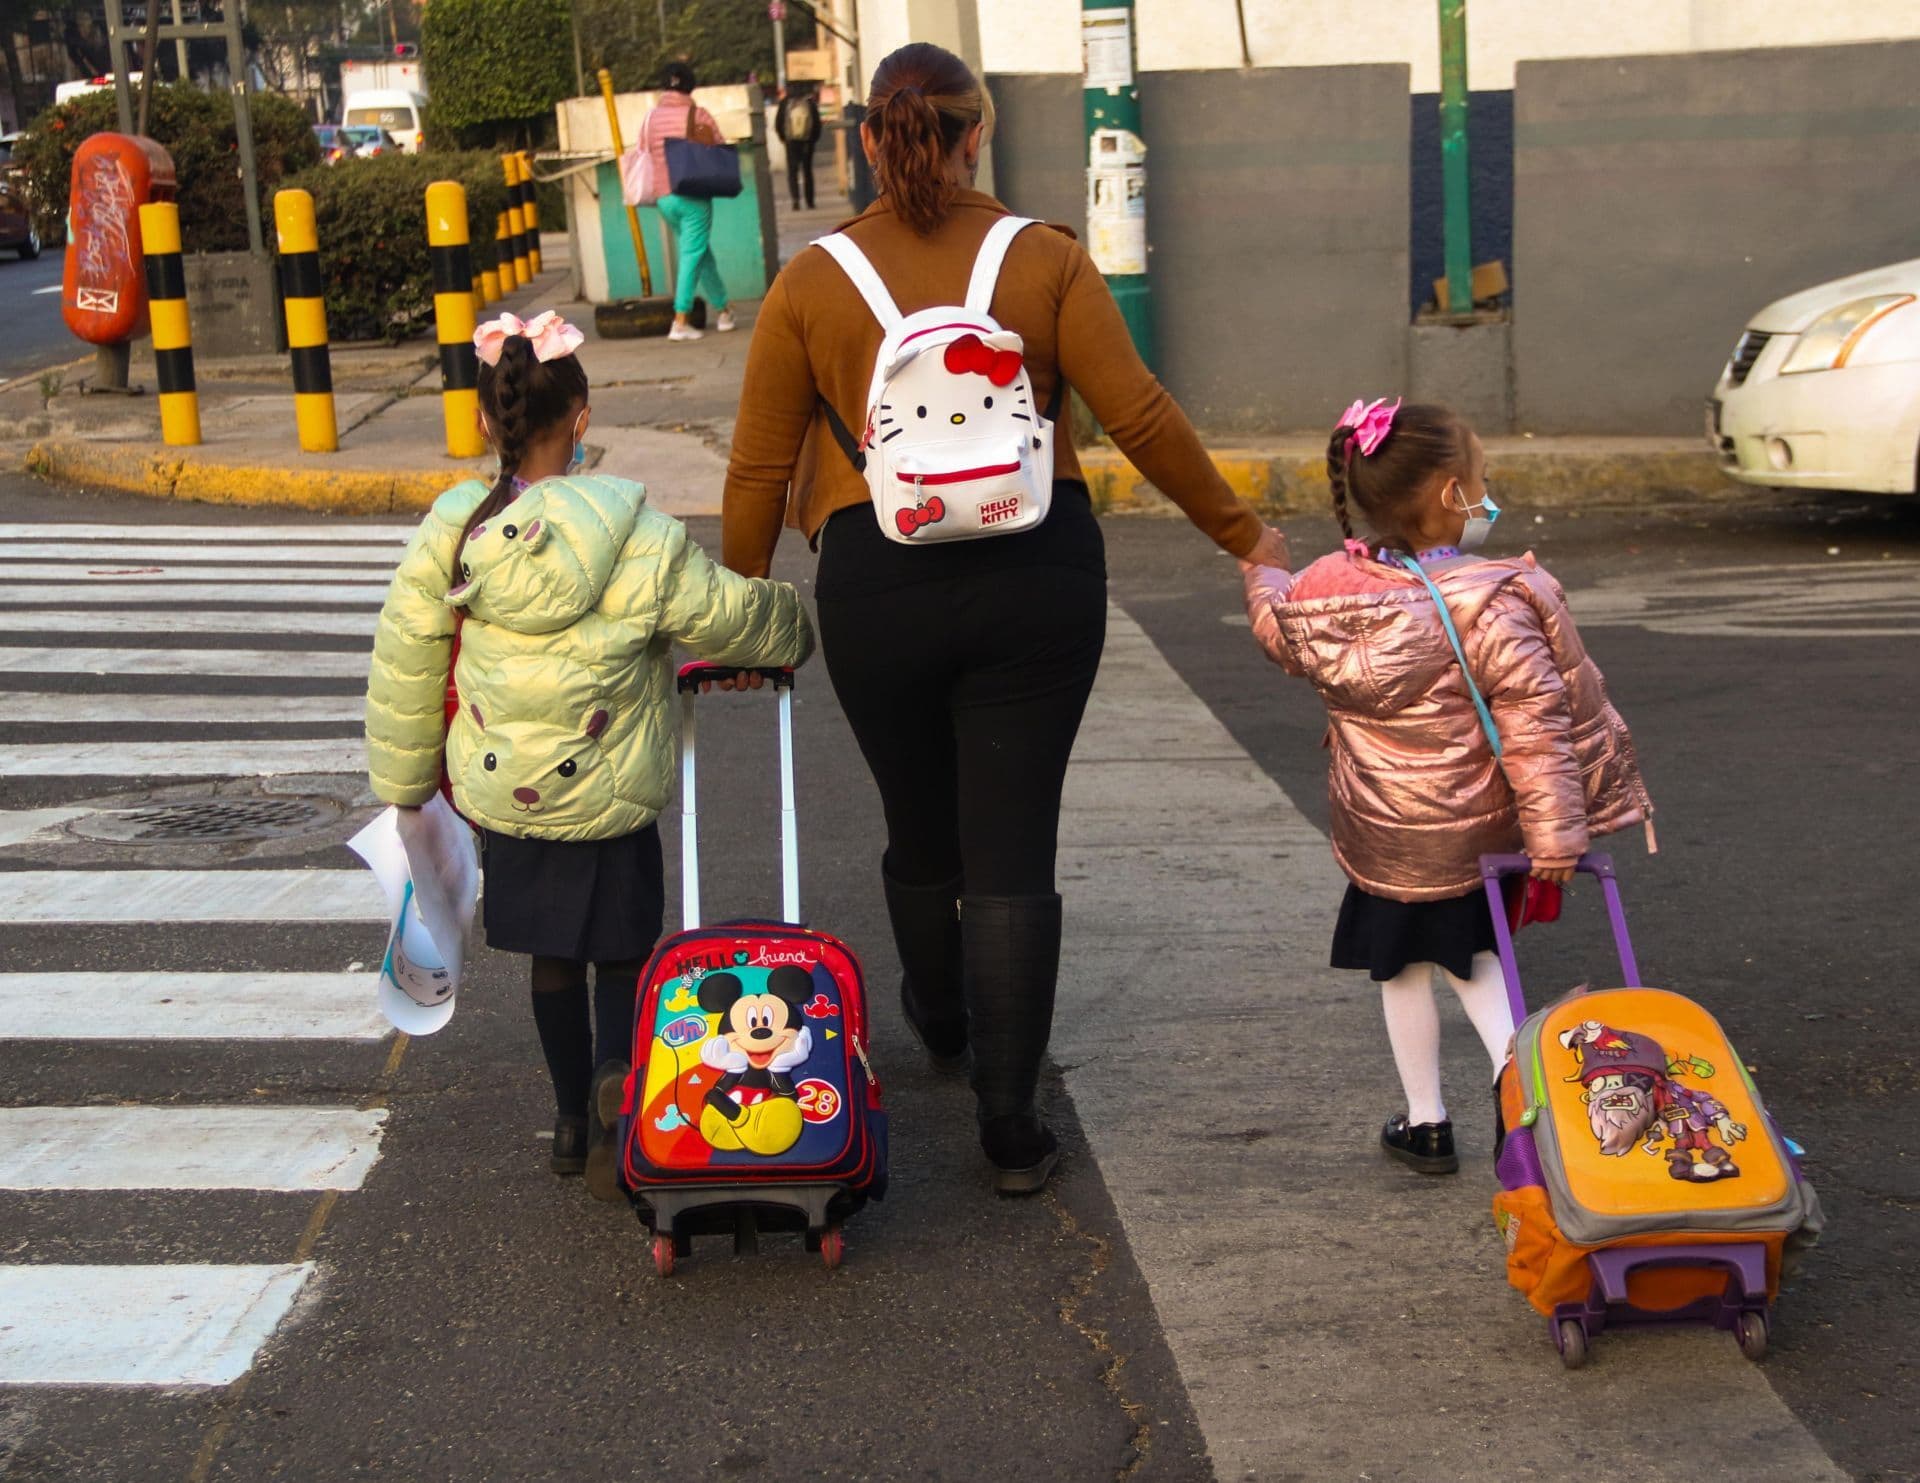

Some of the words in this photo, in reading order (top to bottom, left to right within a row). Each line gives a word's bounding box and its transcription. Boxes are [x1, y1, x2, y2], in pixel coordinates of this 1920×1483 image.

[980, 497, 1018, 514] HELLO
[981, 507, 1018, 525] KITTY
[748, 945, 817, 966] friend
[797, 1084, 836, 1115] 28
